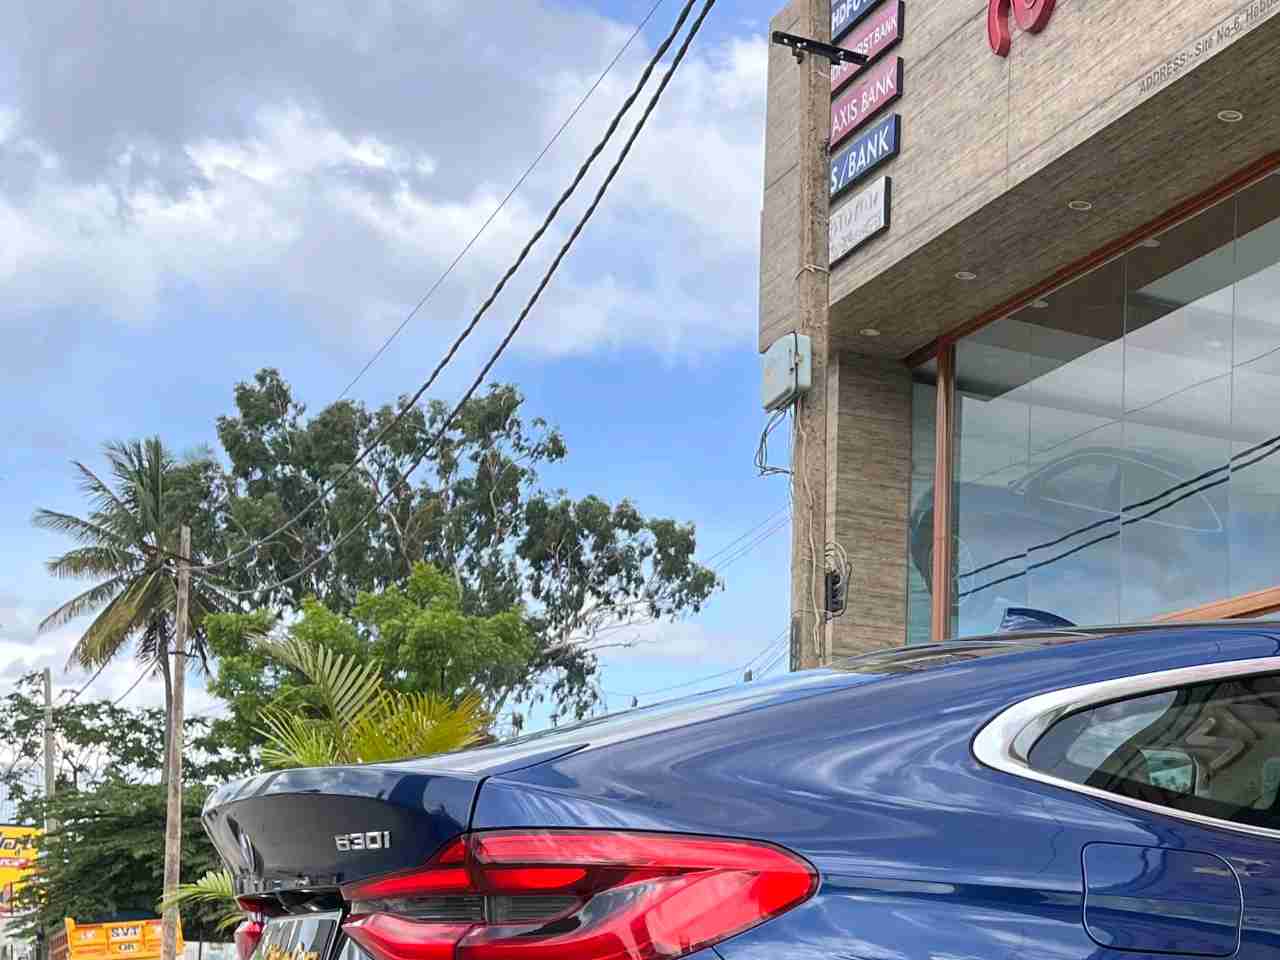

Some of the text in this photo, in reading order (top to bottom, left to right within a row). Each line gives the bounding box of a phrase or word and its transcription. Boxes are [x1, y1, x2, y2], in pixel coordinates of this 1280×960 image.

[873, 15, 897, 41] BANK
[831, 99, 858, 141] AXIS
[861, 67, 894, 113] BANK
